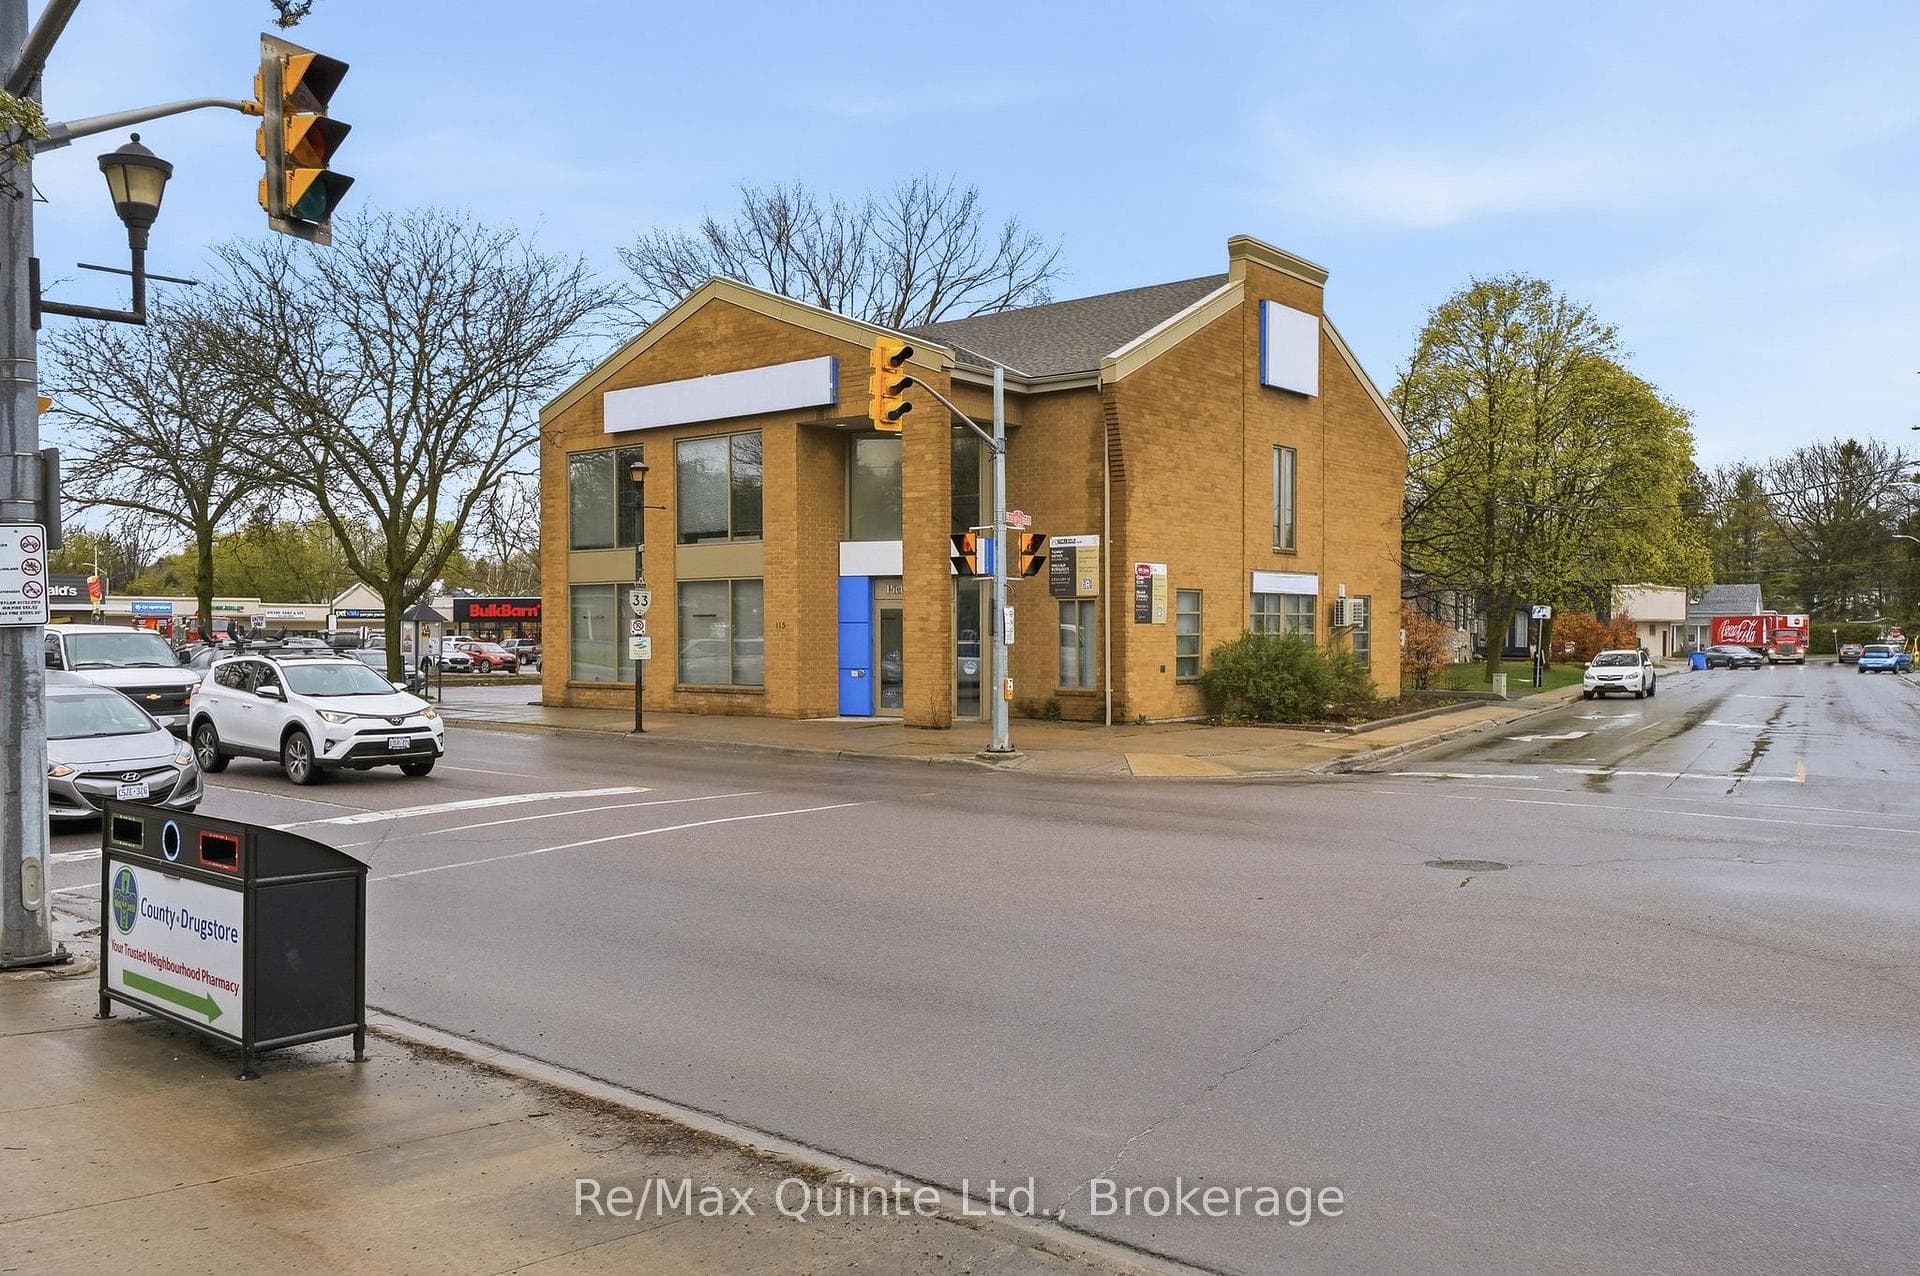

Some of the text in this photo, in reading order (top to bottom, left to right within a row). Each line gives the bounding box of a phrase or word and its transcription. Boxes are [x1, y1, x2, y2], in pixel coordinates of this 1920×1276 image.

[632, 594, 649, 607] 33
[140, 897, 239, 944] County Drugstore
[124, 943, 147, 963] Trusted
[147, 951, 201, 981] Neighbourhood
[201, 969, 240, 997] Pharmacy
